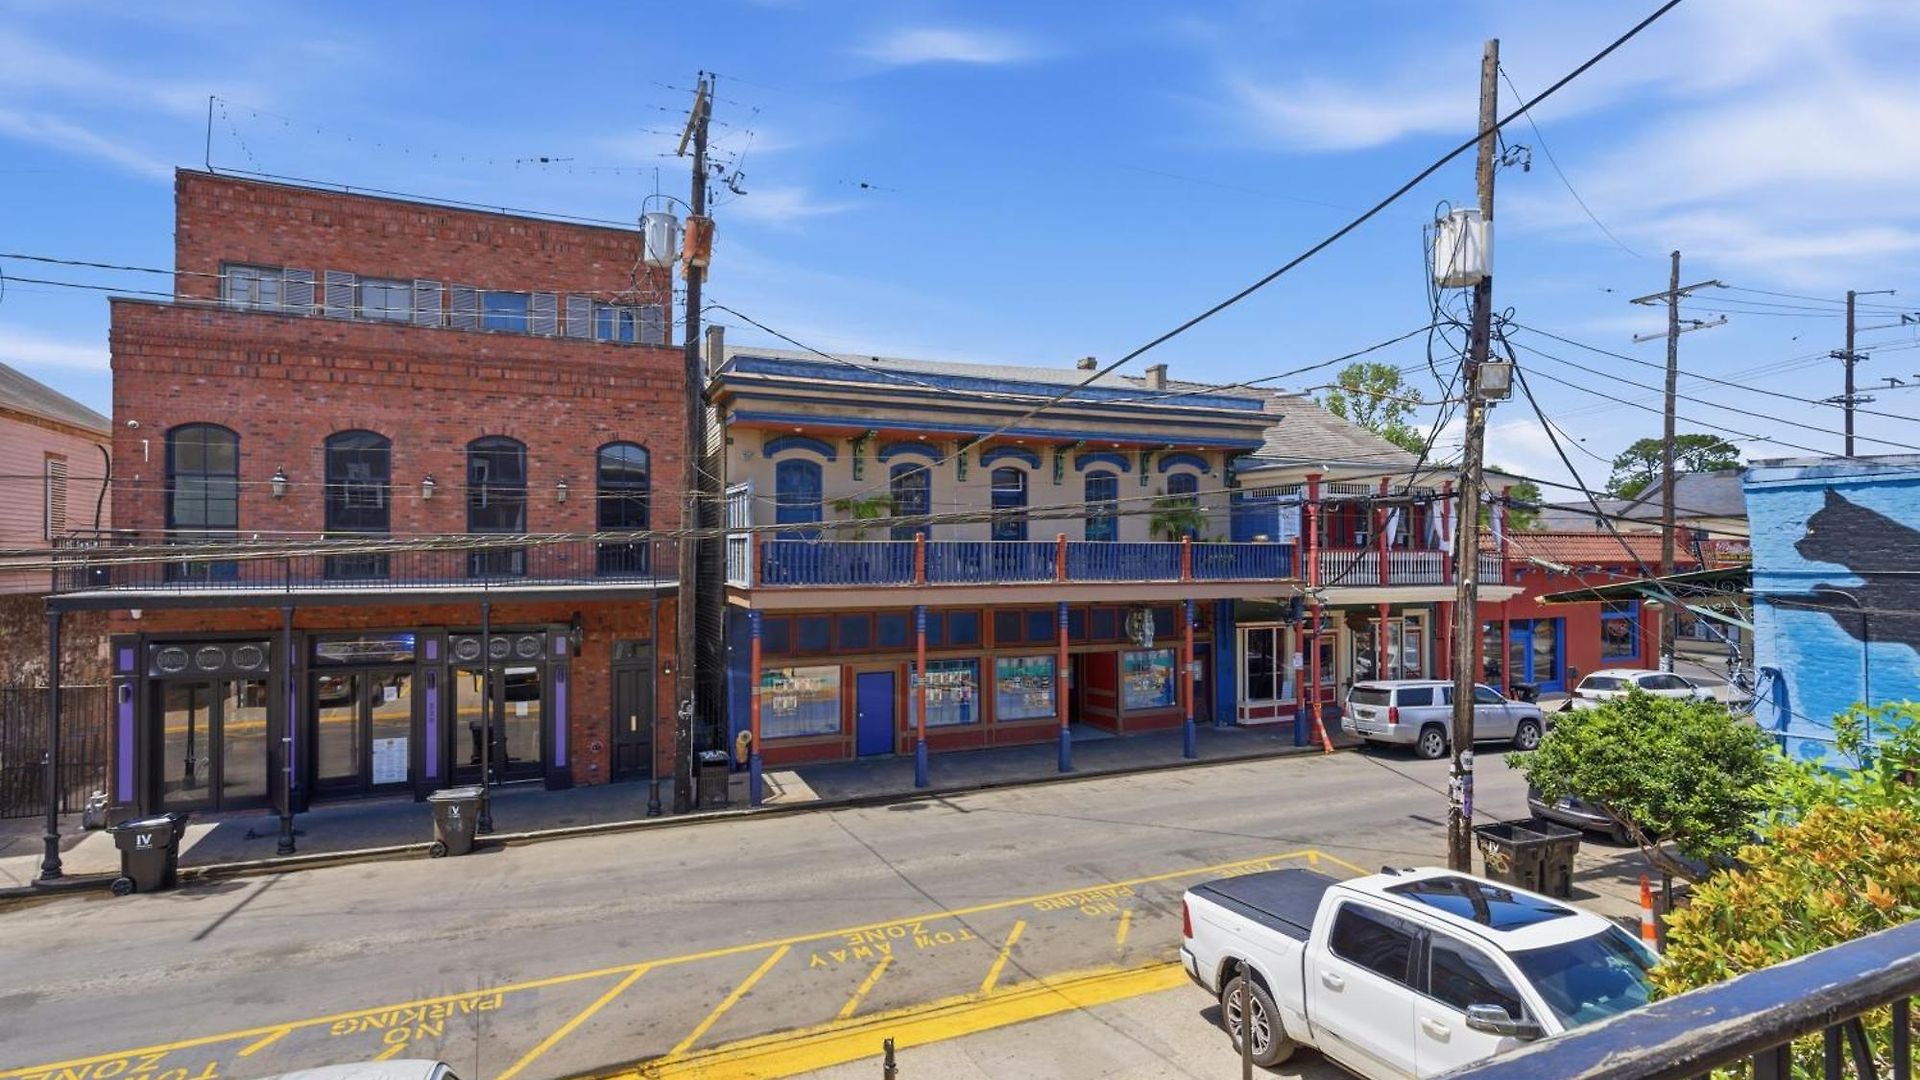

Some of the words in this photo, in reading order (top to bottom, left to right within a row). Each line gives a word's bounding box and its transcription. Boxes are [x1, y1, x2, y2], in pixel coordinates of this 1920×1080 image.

[136, 833, 152, 846] IV
[1033, 886, 1135, 912] PARKING
[1080, 900, 1119, 916] NO
[843, 921, 928, 946] ZONE
[913, 927, 977, 949] TOW
[809, 942, 893, 968] AWAY
[330, 992, 503, 1036] PARKING
[383, 1019, 444, 1044] NO
[124, 1060, 219, 1080] TO
